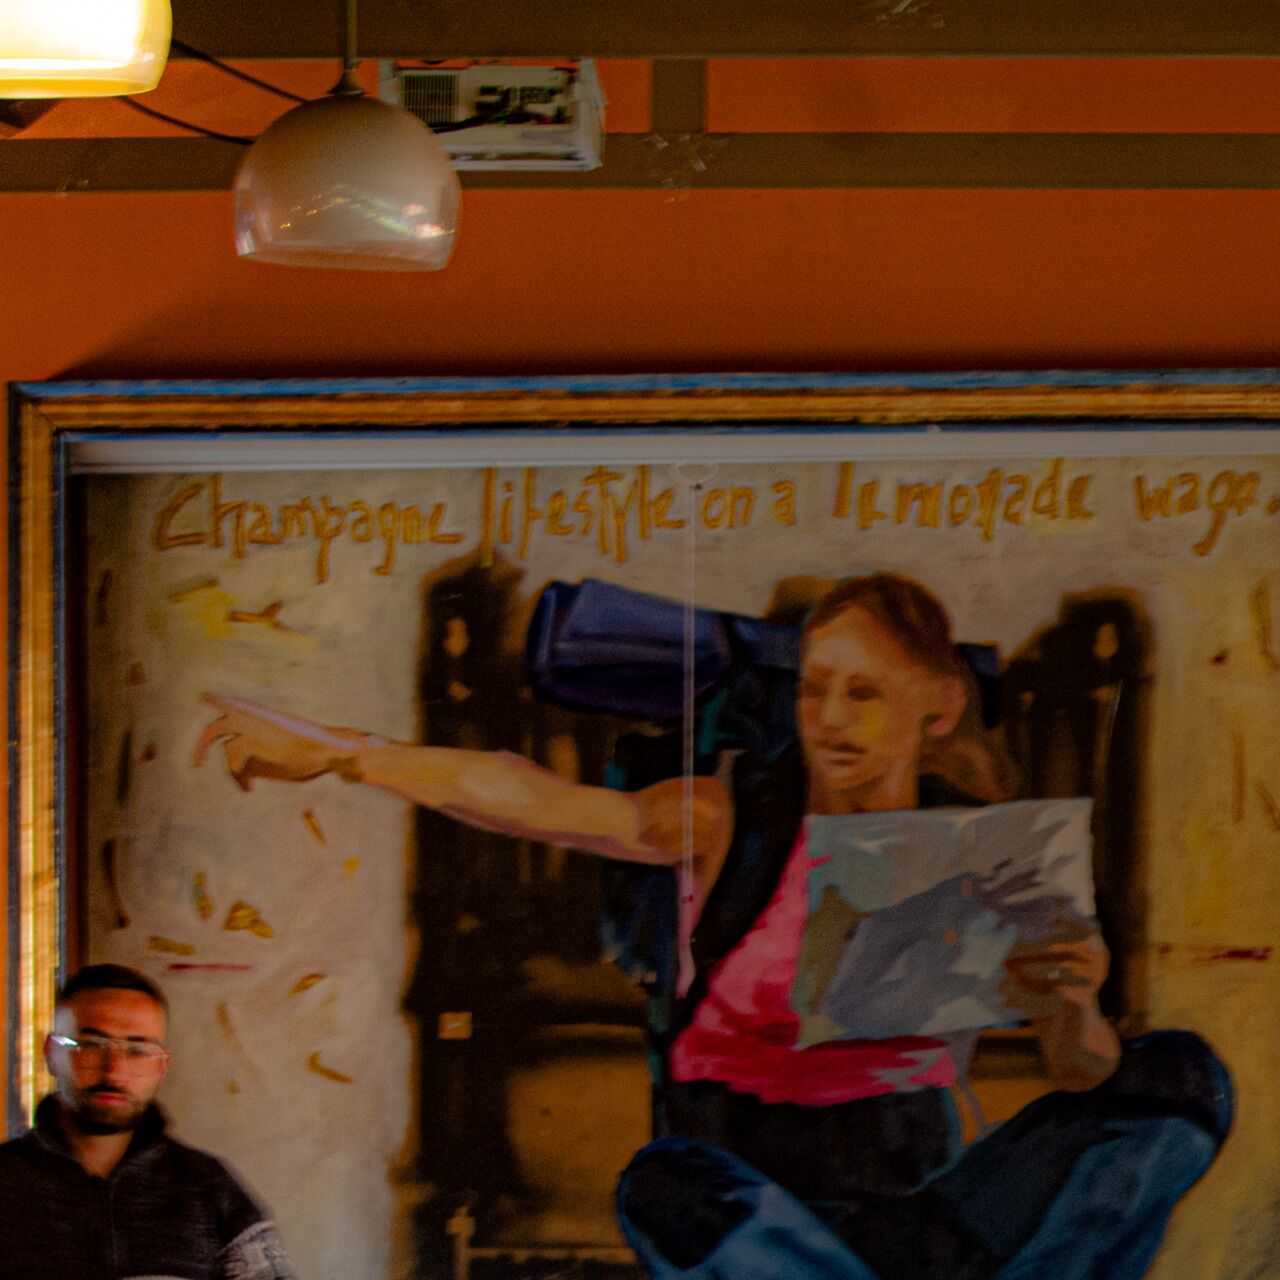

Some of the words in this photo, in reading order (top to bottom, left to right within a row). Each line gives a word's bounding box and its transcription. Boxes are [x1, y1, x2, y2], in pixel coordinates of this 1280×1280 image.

[155, 470, 463, 583] Champagne
[480, 464, 686, 568] lifestyle
[701, 485, 756, 529] on
[770, 478, 797, 527] a
